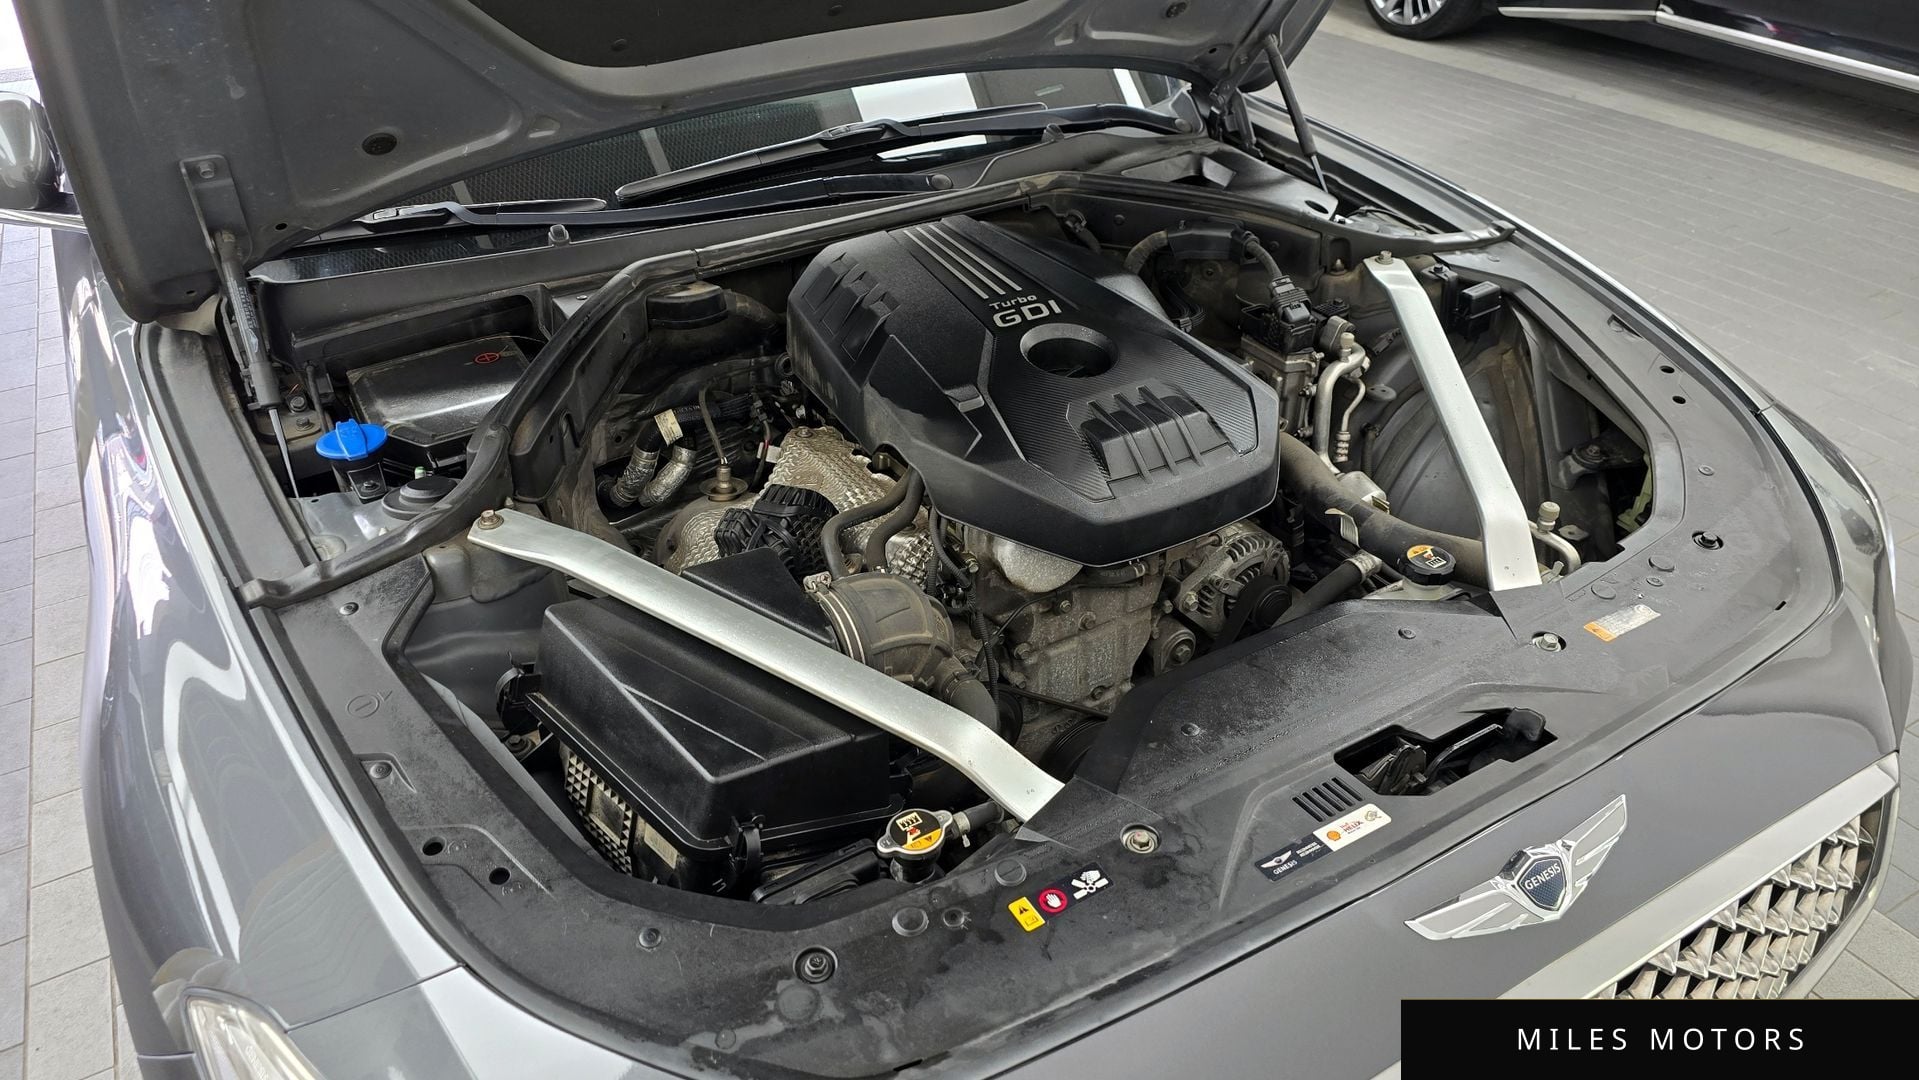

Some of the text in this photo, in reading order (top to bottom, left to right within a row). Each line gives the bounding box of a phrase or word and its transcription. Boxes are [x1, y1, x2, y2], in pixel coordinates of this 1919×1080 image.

[989, 295, 1037, 310] Turbo
[992, 300, 1062, 328] GDI
[1273, 859, 1298, 875] GENESIS
[1524, 862, 1561, 890] GENESIS
